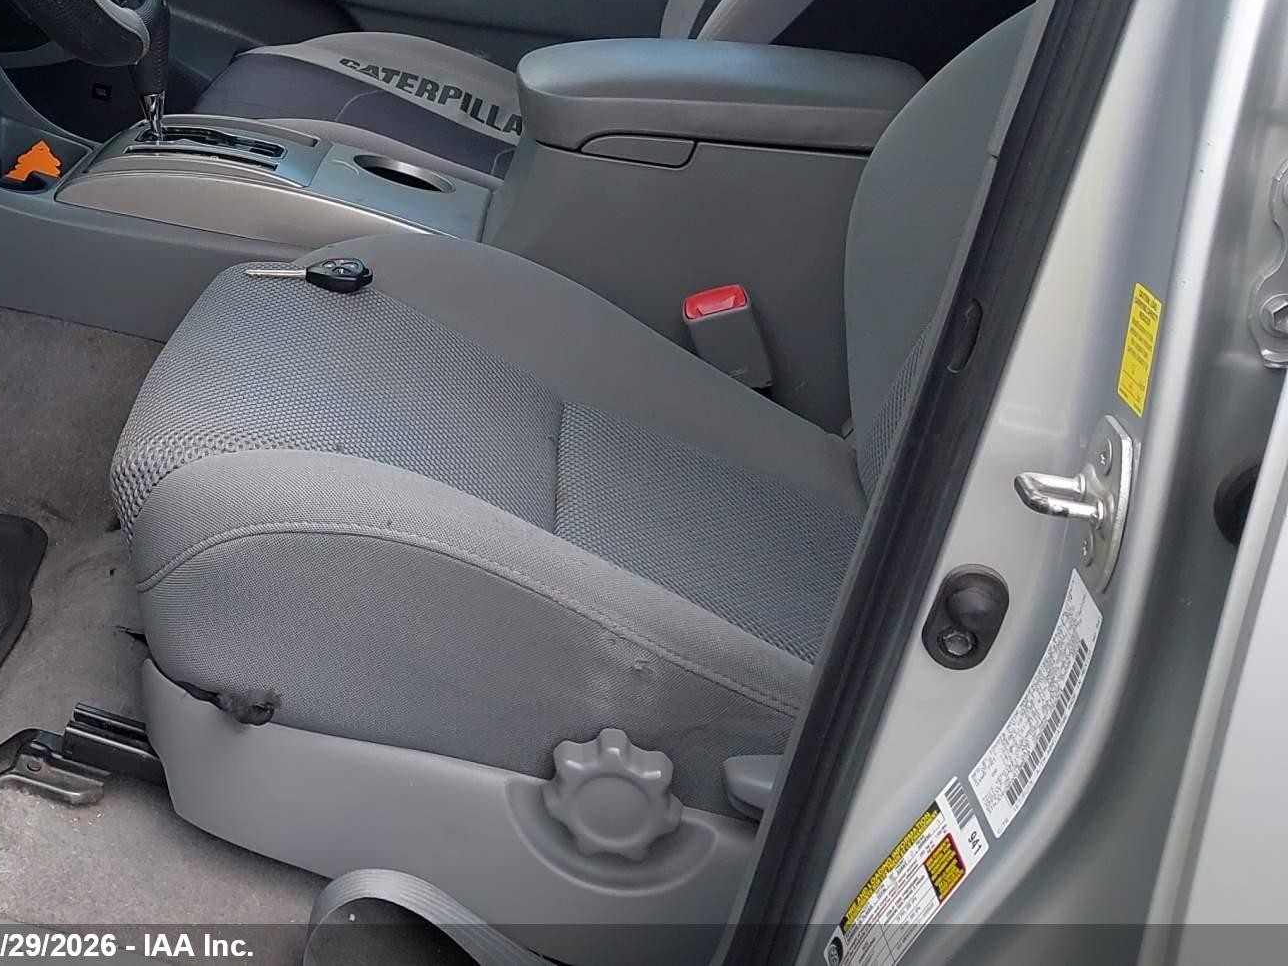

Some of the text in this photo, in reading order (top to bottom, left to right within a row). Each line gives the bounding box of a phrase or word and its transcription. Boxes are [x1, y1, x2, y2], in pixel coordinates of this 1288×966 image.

[338, 57, 523, 136] CATERPILLA
[889, 810, 931, 860] INFORMATION
[966, 830, 983, 857] 941
